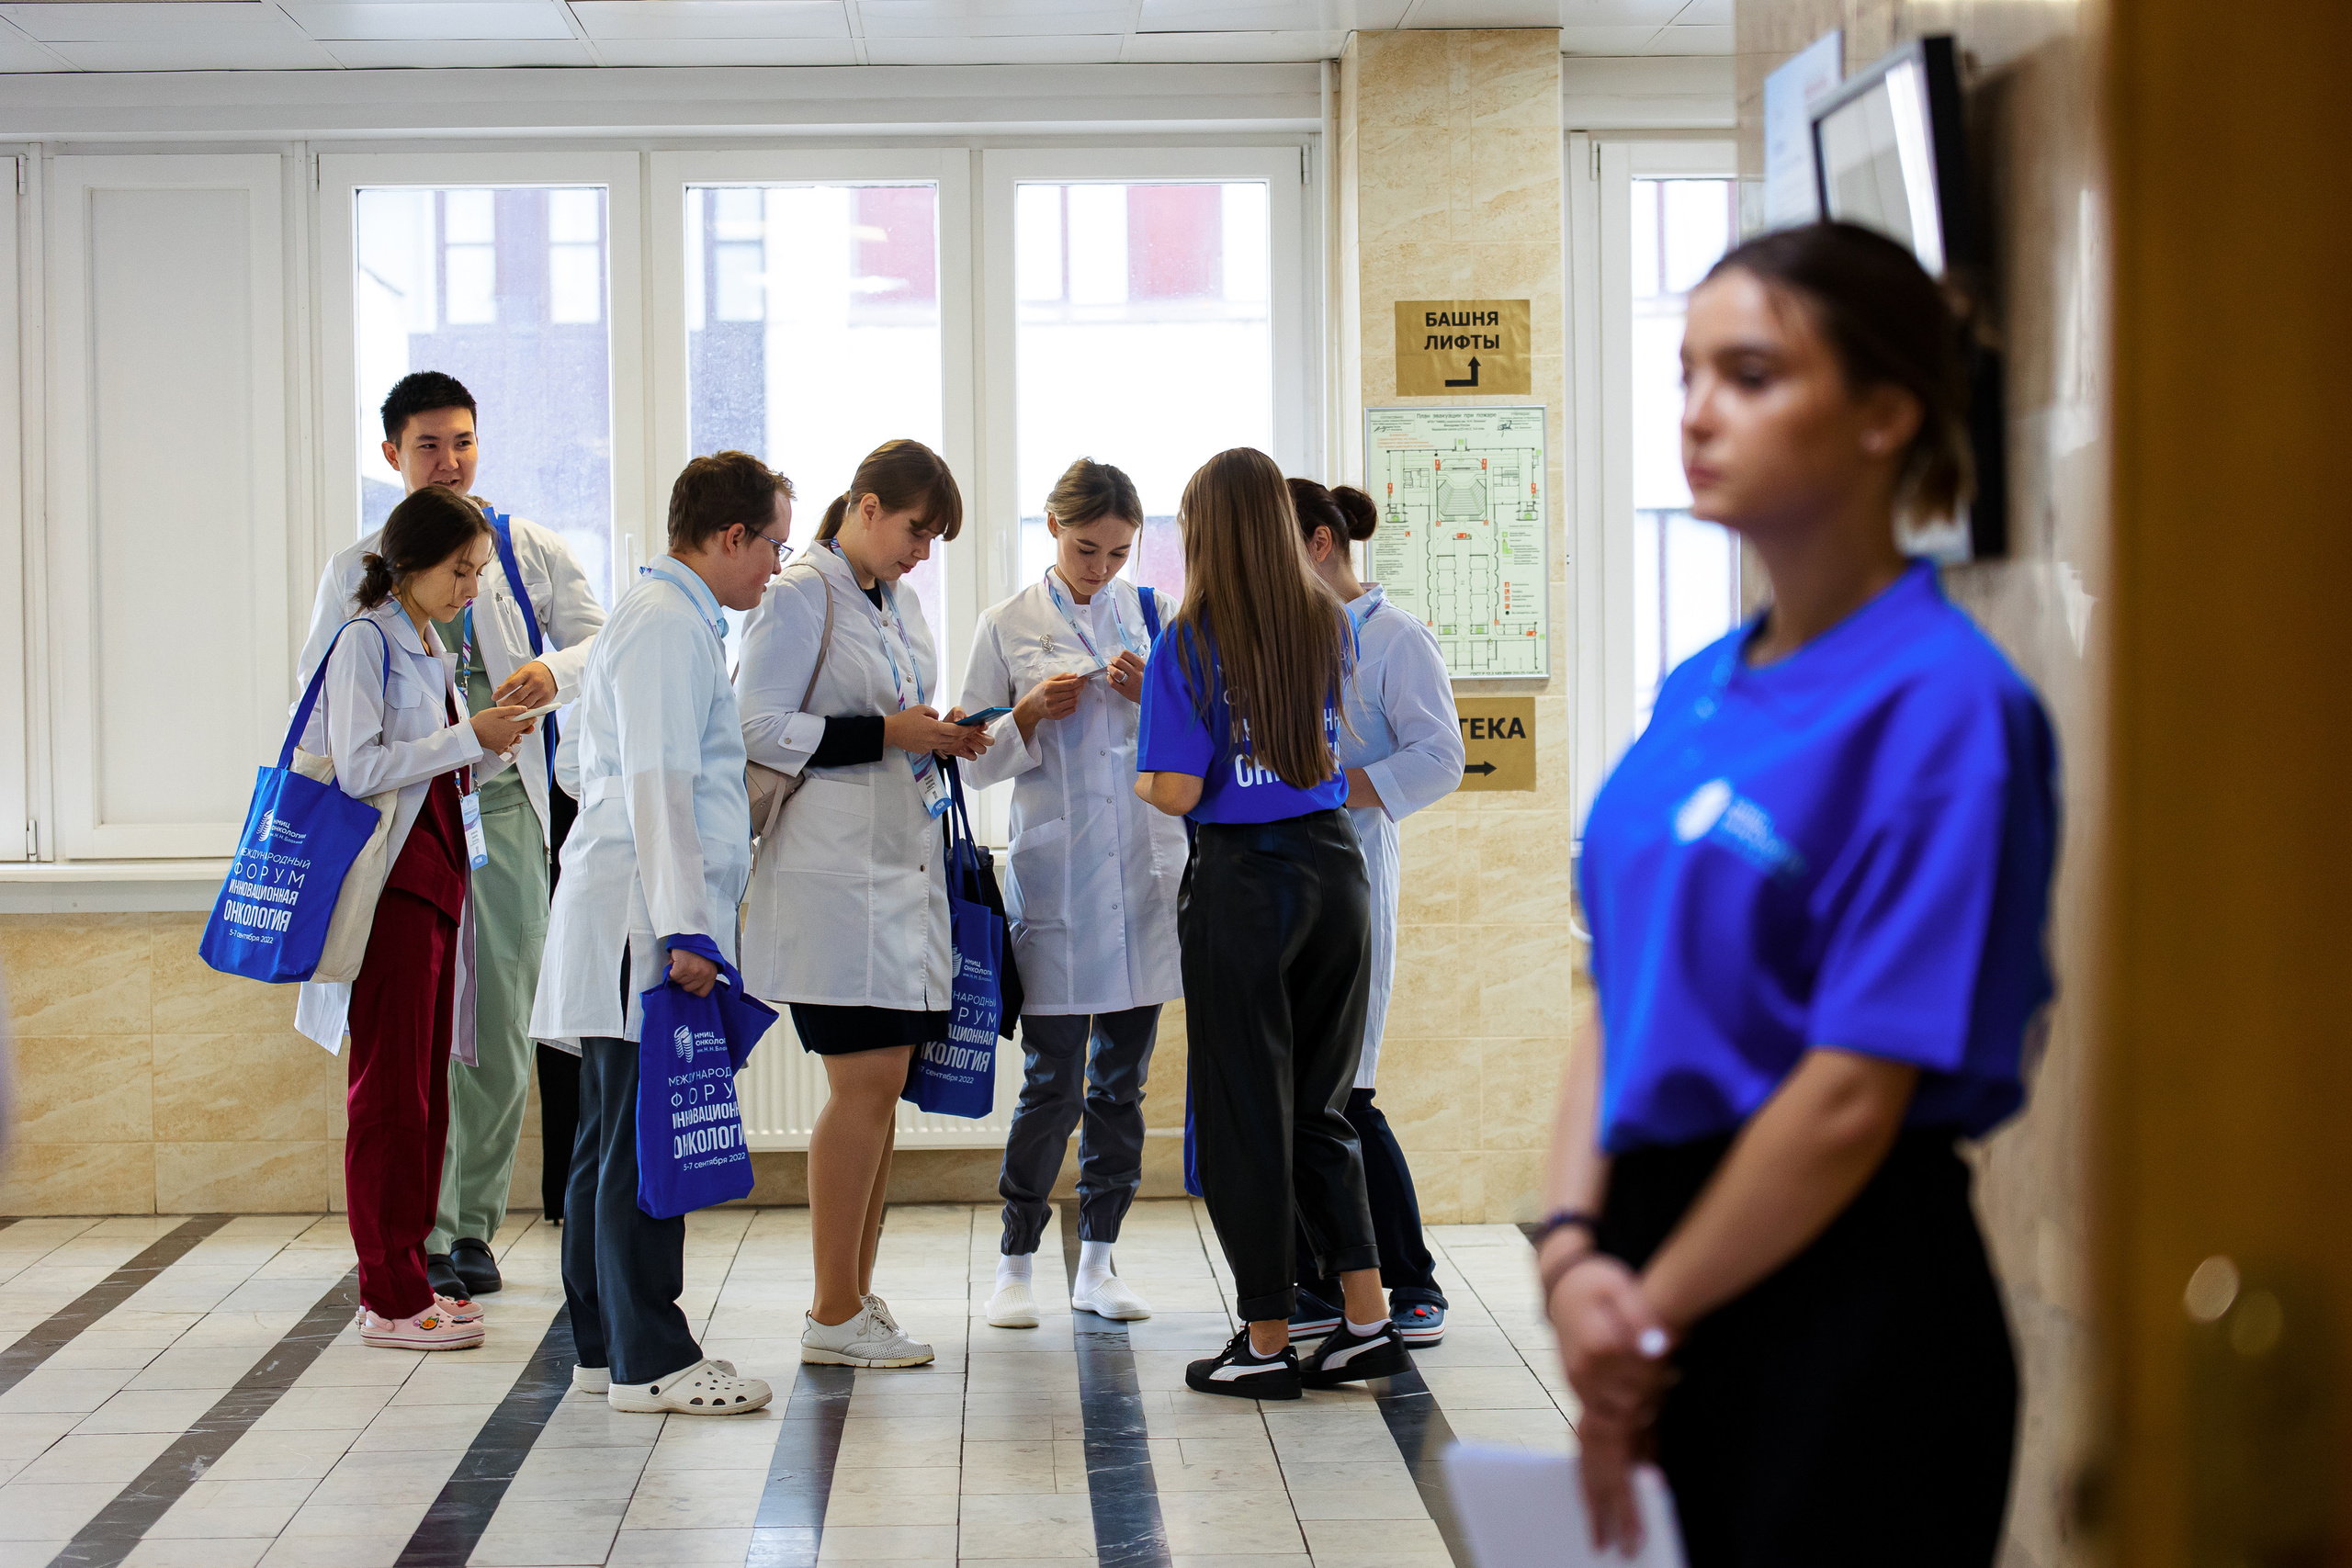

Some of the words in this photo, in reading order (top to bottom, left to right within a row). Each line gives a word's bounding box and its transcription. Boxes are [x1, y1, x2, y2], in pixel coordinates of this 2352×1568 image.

[1425, 311, 1498, 327] БАШНЯ
[1424, 334, 1499, 350] ЛИФТЫ
[1458, 717, 1526, 739] ТЕКА
[233, 861, 305, 888] ФОРУМ
[228, 878, 300, 906] ИННОВАЦИОННАЯ
[223, 899, 292, 932] ОНКОЛОГИЯ
[229, 928, 237, 937] 5-7
[260, 935, 274, 943] 2022
[965, 957, 980, 967] НМИЦ
[953, 991, 996, 1007] НАРОДНЫ
[957, 1007, 997, 1028] РУМ
[695, 1038, 726, 1046] ОНКОЛО
[948, 1023, 995, 1046] АЦИОННАЯ
[921, 1041, 991, 1073] КОЛОГИЯ
[668, 1066, 732, 1087] МЕЖДУНАРОД
[925, 1068, 957, 1082] сентября
[958, 1075, 974, 1084] 2022
[671, 1081, 733, 1108] ФОРУ
[673, 1101, 740, 1129] ИННОВАЦИОНН
[673, 1123, 746, 1159] ОНКОЛОГИ
[683, 1162, 693, 1171] 5-7
[694, 1156, 728, 1169] сентября
[729, 1152, 746, 1163] 2022
